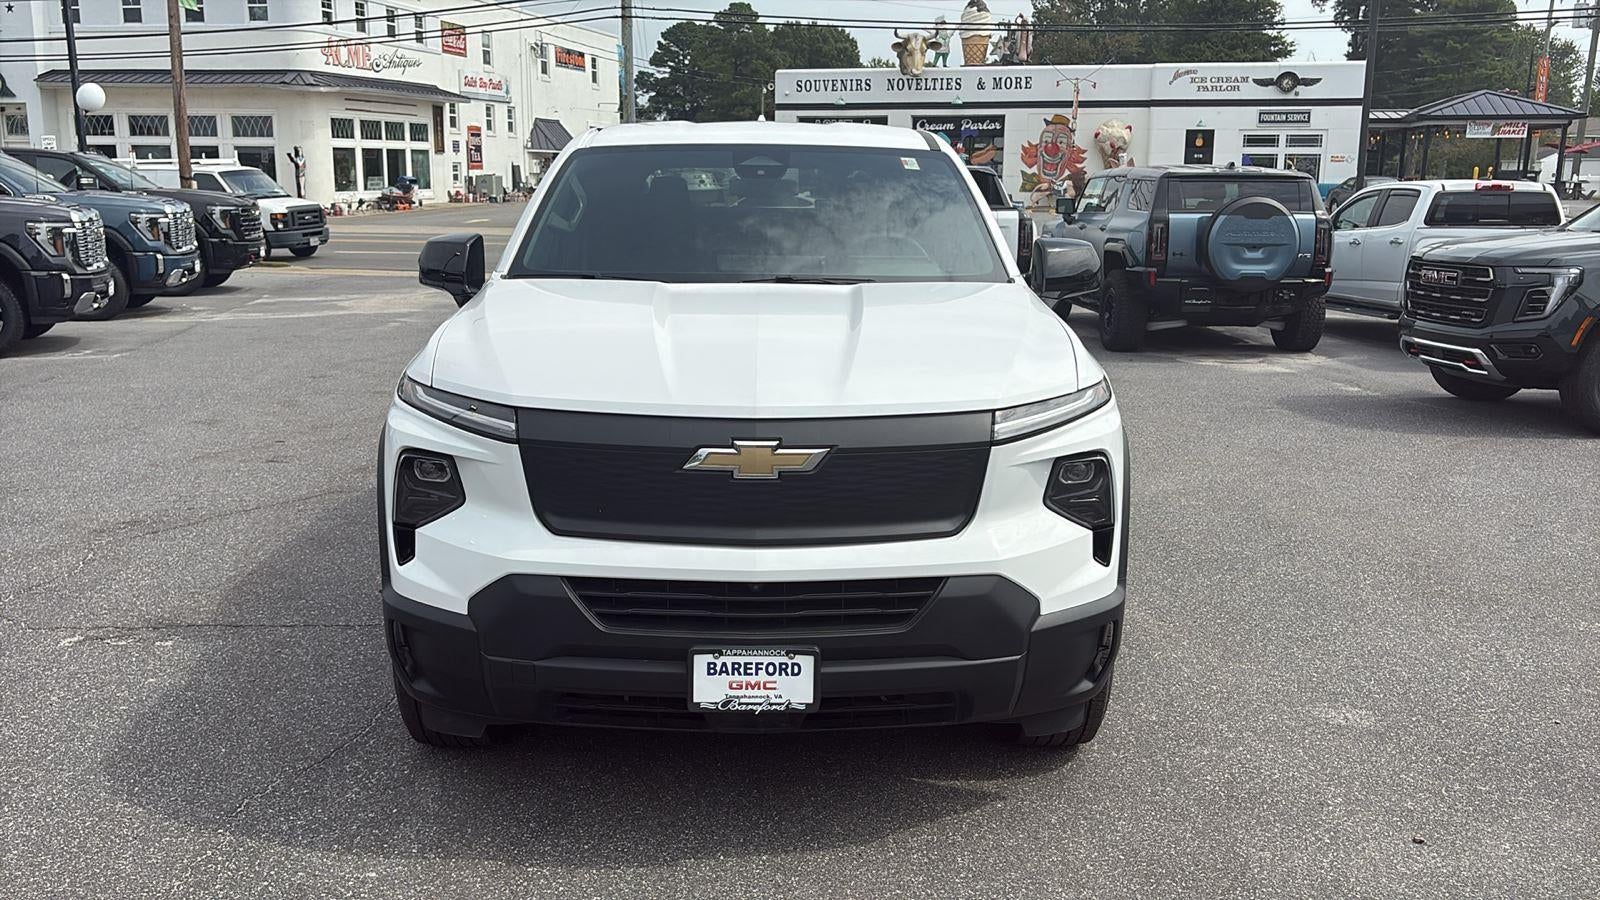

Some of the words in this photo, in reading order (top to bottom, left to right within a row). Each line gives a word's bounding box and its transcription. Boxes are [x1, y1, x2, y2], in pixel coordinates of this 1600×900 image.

[321, 36, 372, 71] ACME
[377, 47, 422, 75] Antiques
[796, 78, 872, 93] SOUVENIRS
[886, 77, 962, 92] NOVELTIES
[976, 77, 986, 90] &
[992, 76, 1033, 90] MORE
[1190, 76, 1208, 84] ICE
[1209, 76, 1250, 84] CREAM
[1197, 84, 1241, 92] PARLOR
[1260, 112, 1286, 122] FOUNTAIN
[1287, 112, 1309, 122] SERVICE
[916, 118, 955, 131] Cream
[961, 118, 1002, 131] Parlor
[1503, 121, 1528, 129] MILK
[1421, 269, 1457, 285] GMC
[721, 649, 787, 657] TAPPAHANNOCK
[706, 661, 802, 677] BAREFORD
[728, 680, 778, 691] GMC
[718, 699, 790, 714] Bareford
